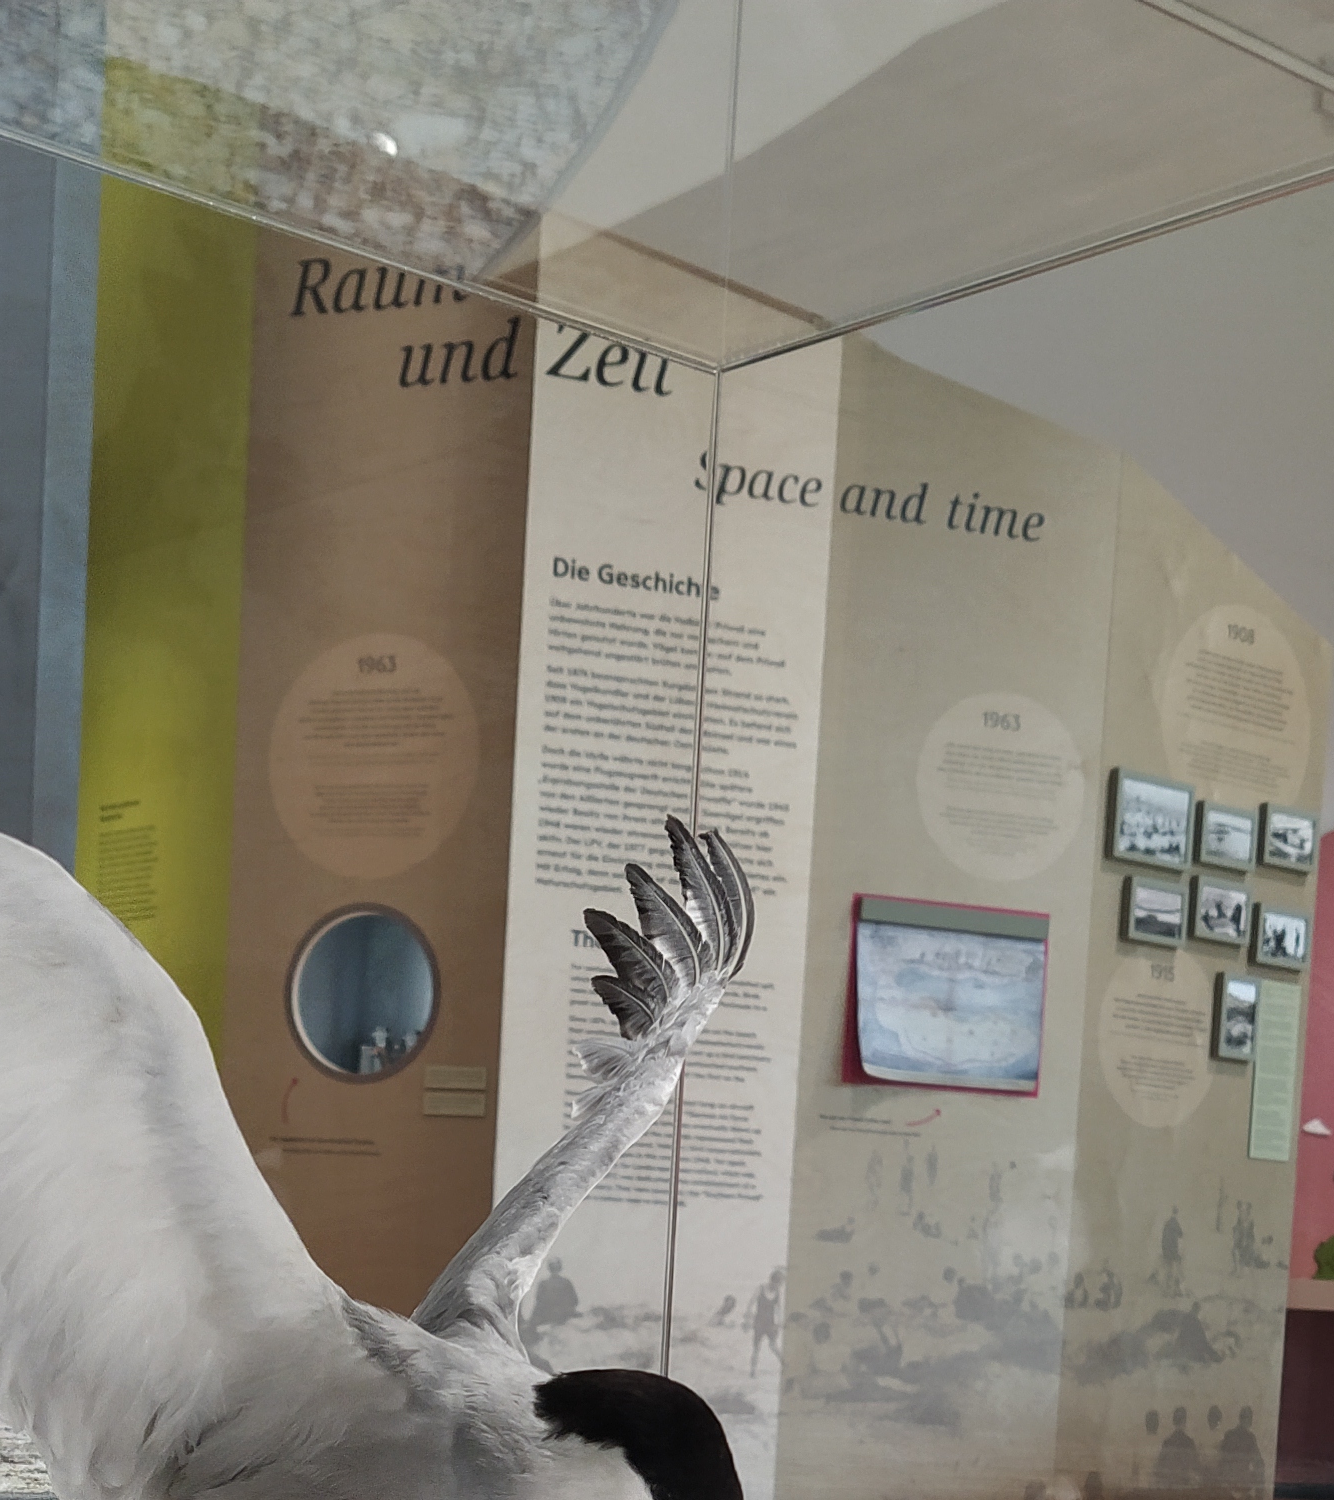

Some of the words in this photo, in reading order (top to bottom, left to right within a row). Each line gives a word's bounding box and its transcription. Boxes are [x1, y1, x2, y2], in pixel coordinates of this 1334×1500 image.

[399, 316, 523, 388] und
[839, 482, 929, 525] and
[945, 492, 1046, 542] time
[552, 557, 590, 581] Die
[597, 563, 720, 600] Geschiche
[982, 709, 1021, 732] 1963
